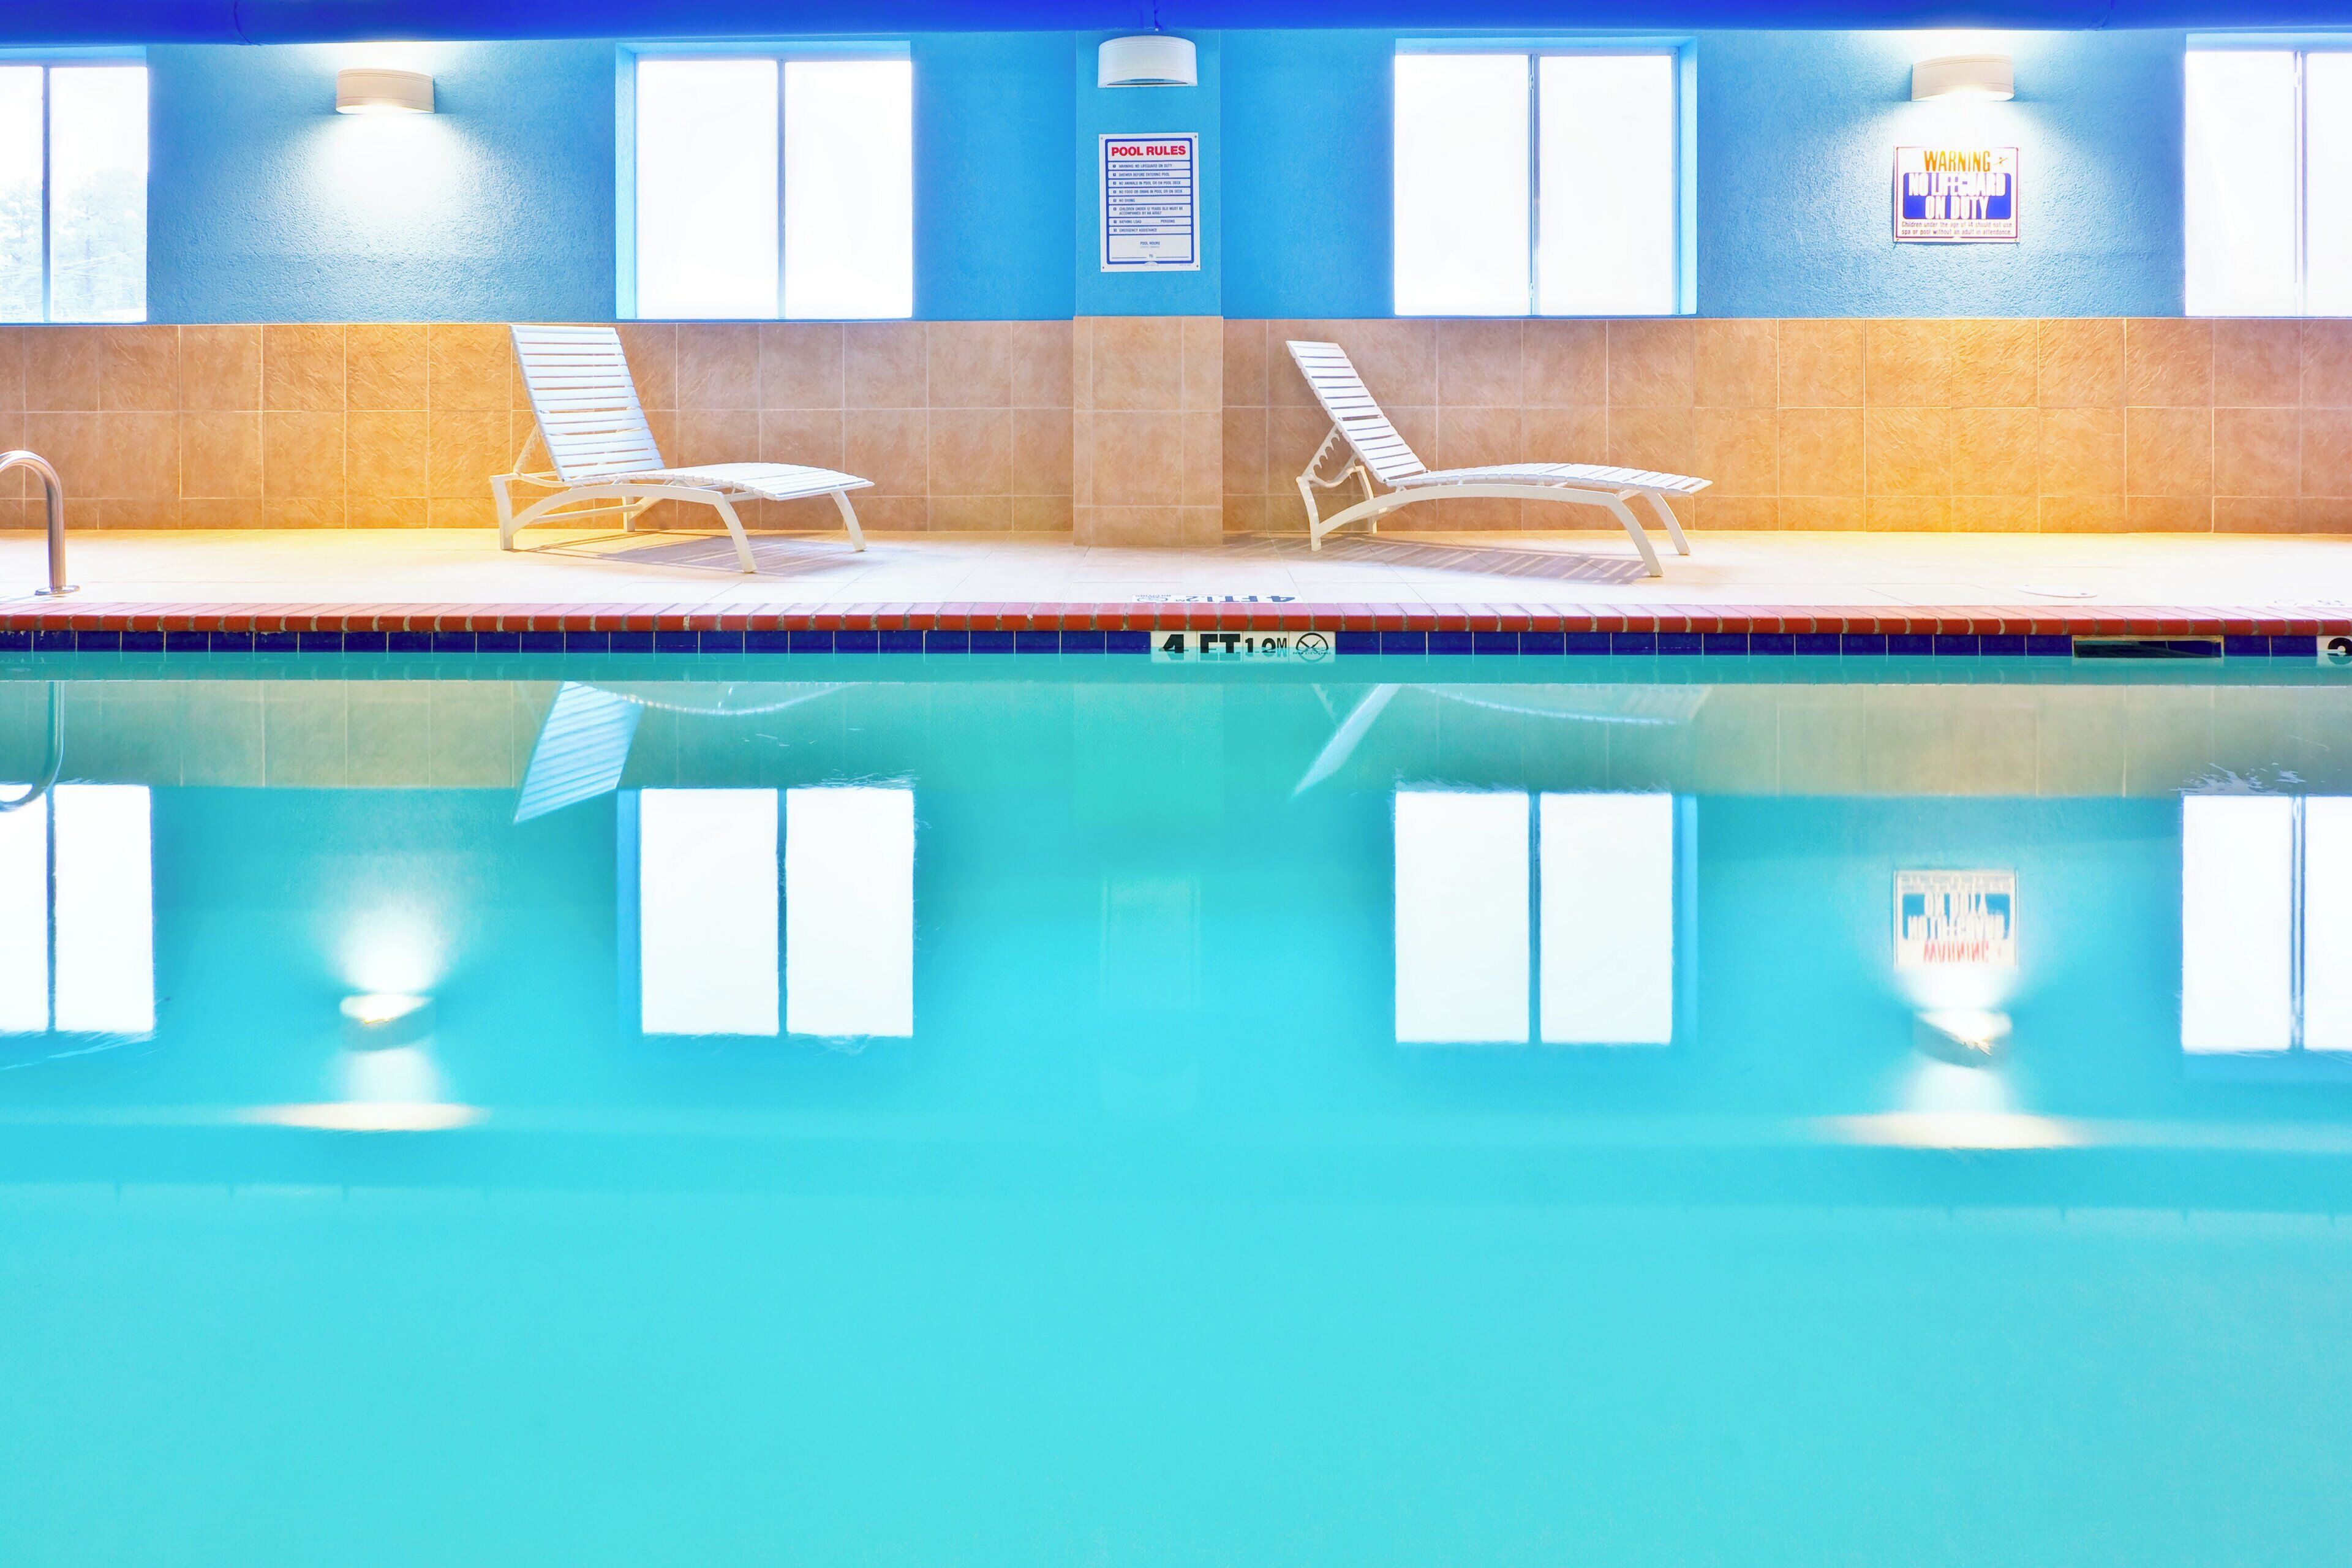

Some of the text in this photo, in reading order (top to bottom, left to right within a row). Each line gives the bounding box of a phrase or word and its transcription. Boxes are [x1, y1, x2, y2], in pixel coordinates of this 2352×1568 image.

[1112, 146, 1186, 156] POOL RULES
[1924, 151, 1990, 172] WARNING
[1909, 173, 2005, 196] NO LIFEGUARD
[1925, 196, 1989, 219] ON DUTY
[1158, 634, 1189, 654] 4
